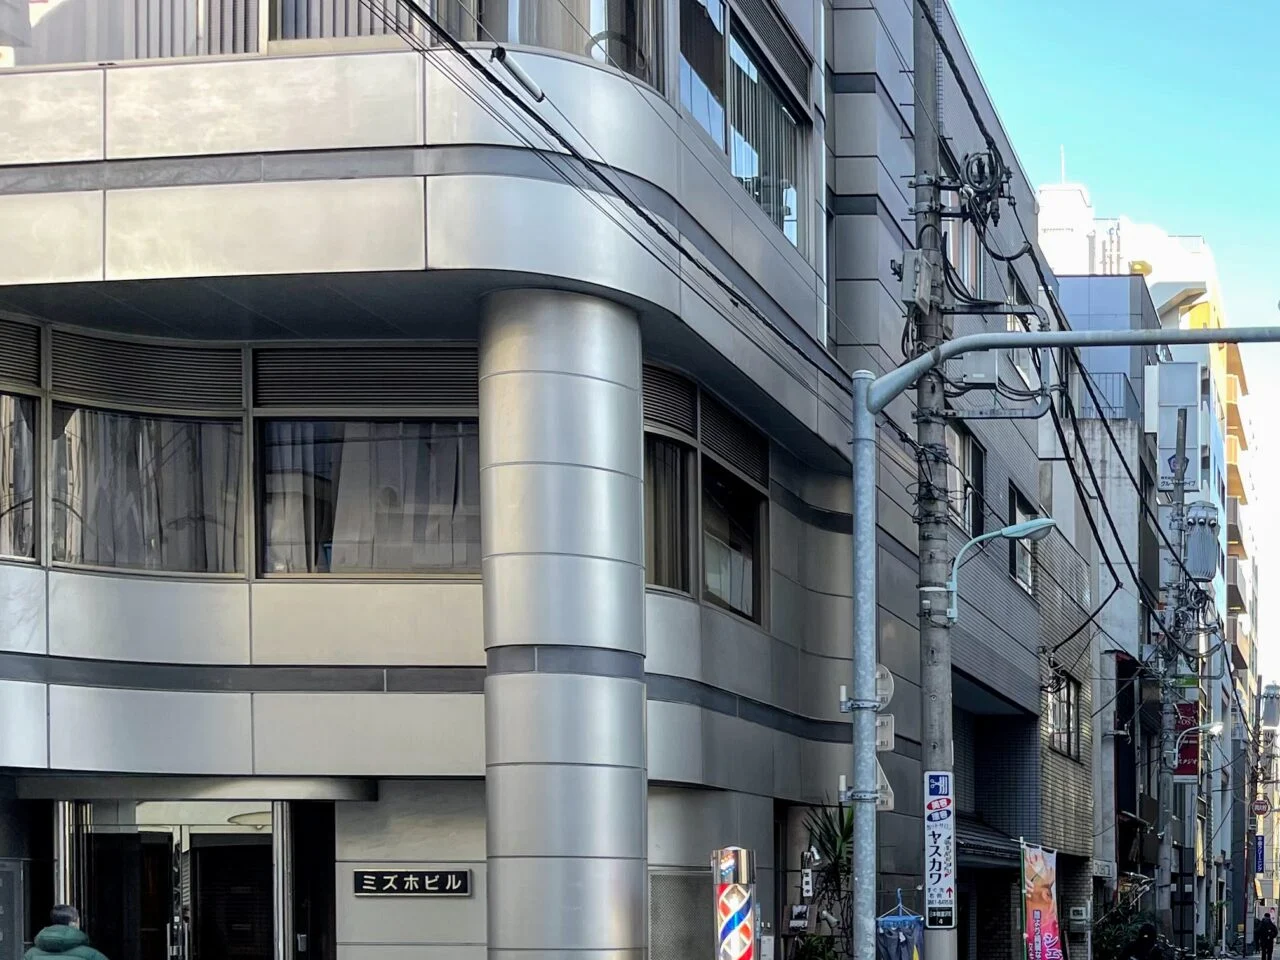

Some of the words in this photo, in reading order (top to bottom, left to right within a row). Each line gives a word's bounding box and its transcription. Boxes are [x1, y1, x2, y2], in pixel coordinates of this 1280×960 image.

[928, 831, 942, 886] ヤスカワ
[362, 874, 462, 891] ミズホビル
